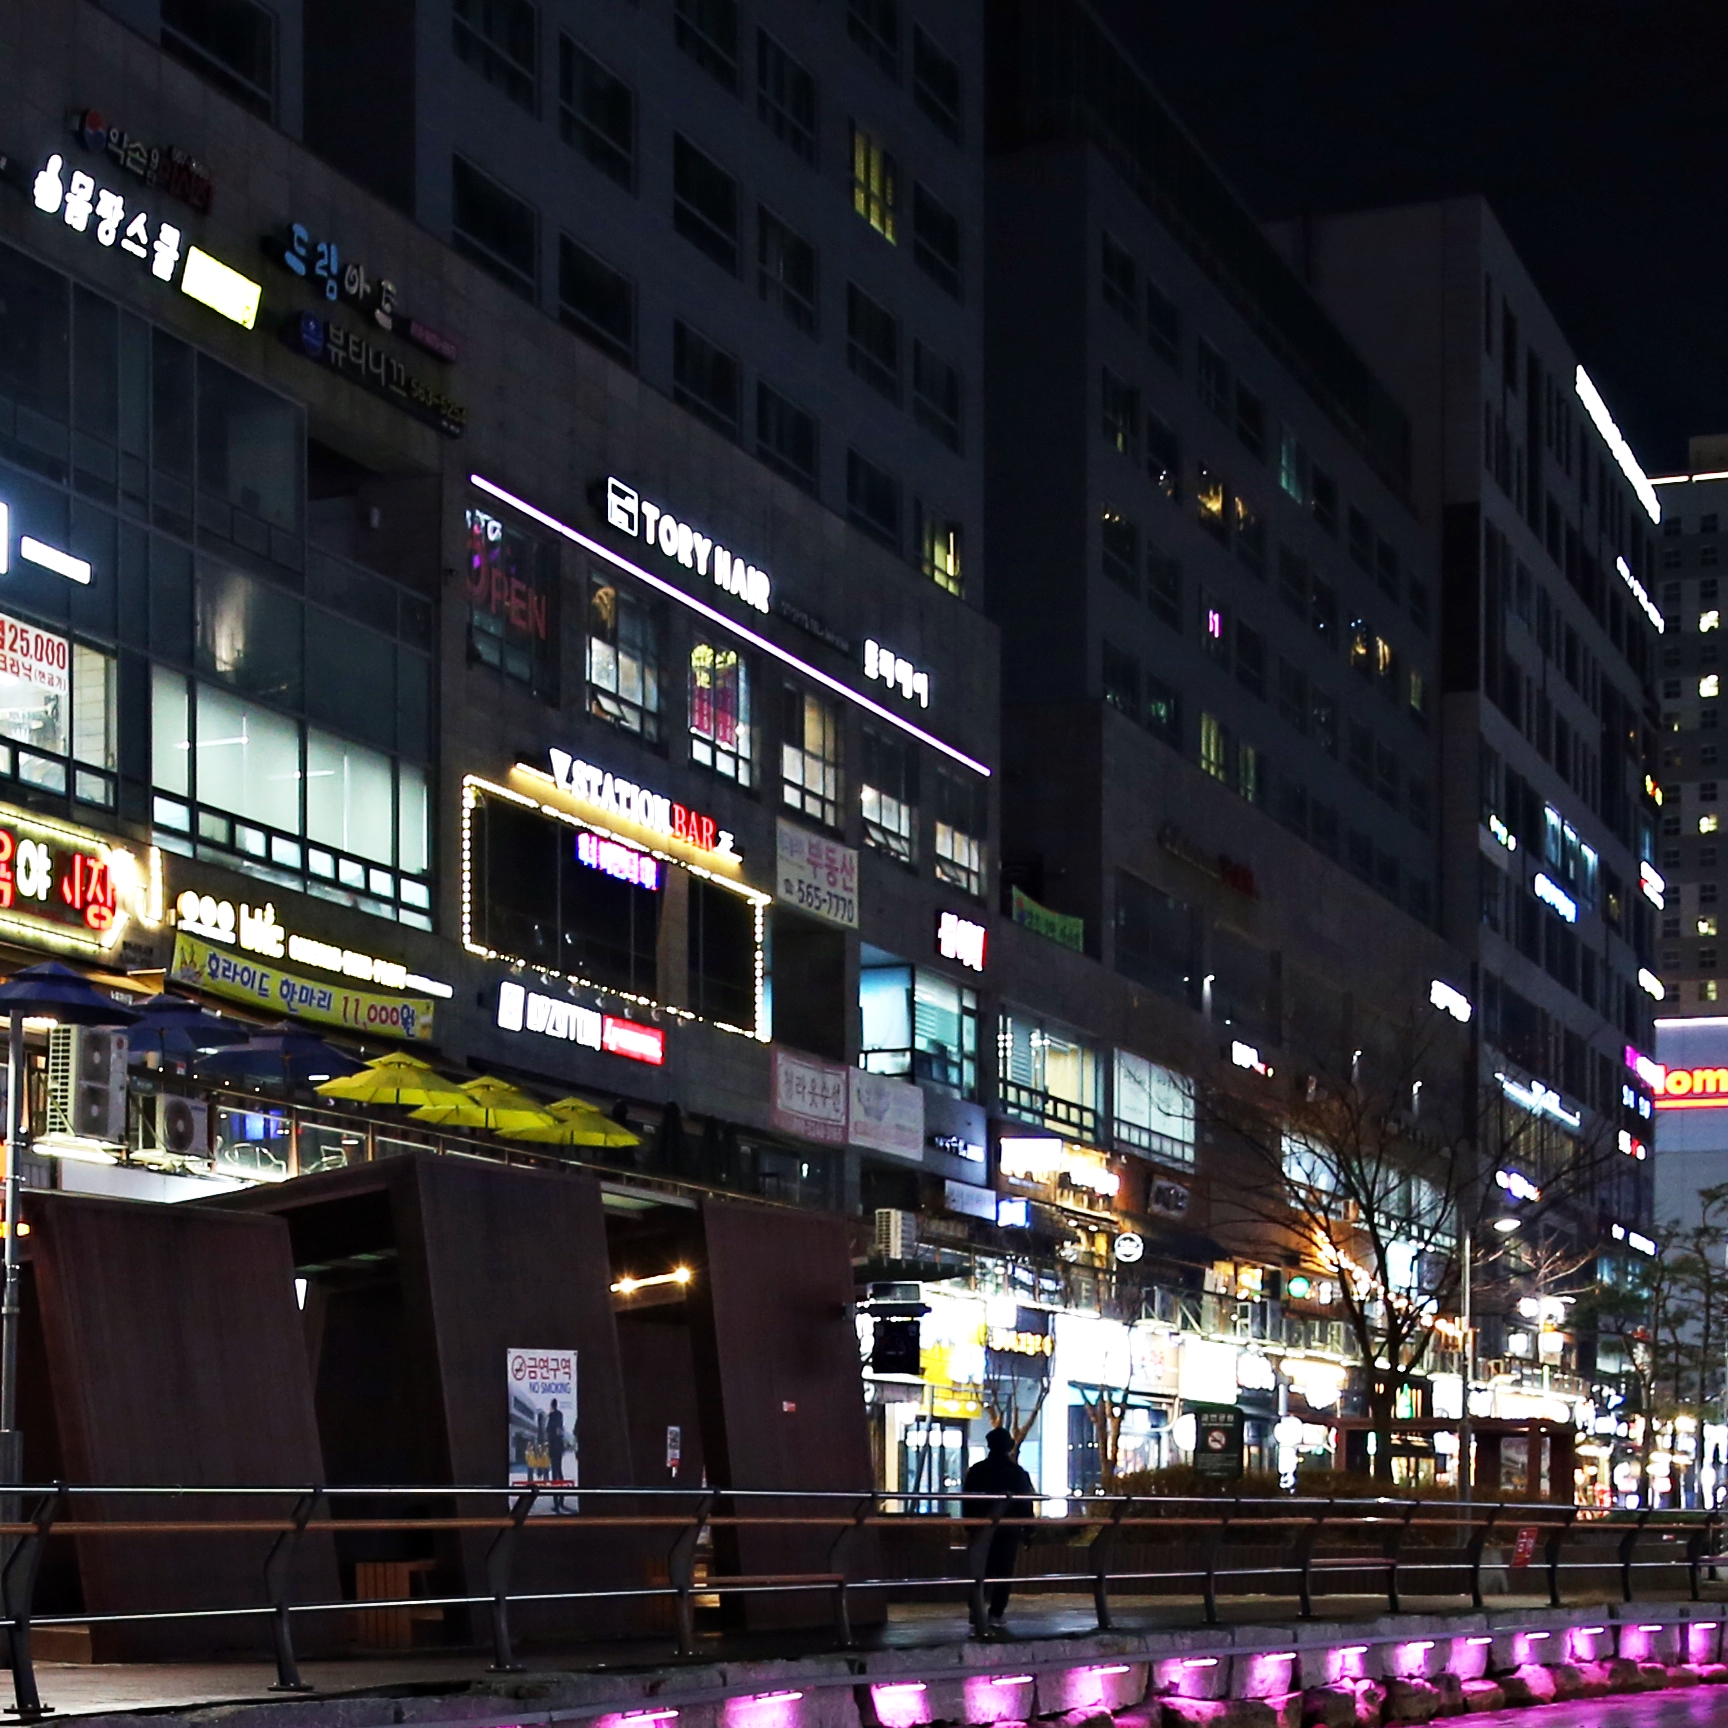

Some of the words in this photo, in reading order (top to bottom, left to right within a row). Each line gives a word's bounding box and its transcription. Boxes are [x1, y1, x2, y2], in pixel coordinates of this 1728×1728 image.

[641, 500, 714, 576] TORY
[715, 545, 772, 614] HAIR
[572, 760, 674, 835] STATION
[673, 803, 715, 852] BAR
[805, 836, 855, 893] 부동산
[279, 978, 333, 1015] 한마리
[526, 1357, 572, 1381] 금연구역
[529, 1381, 540, 1394] NO
[541, 1381, 572, 1395] SMOKING
